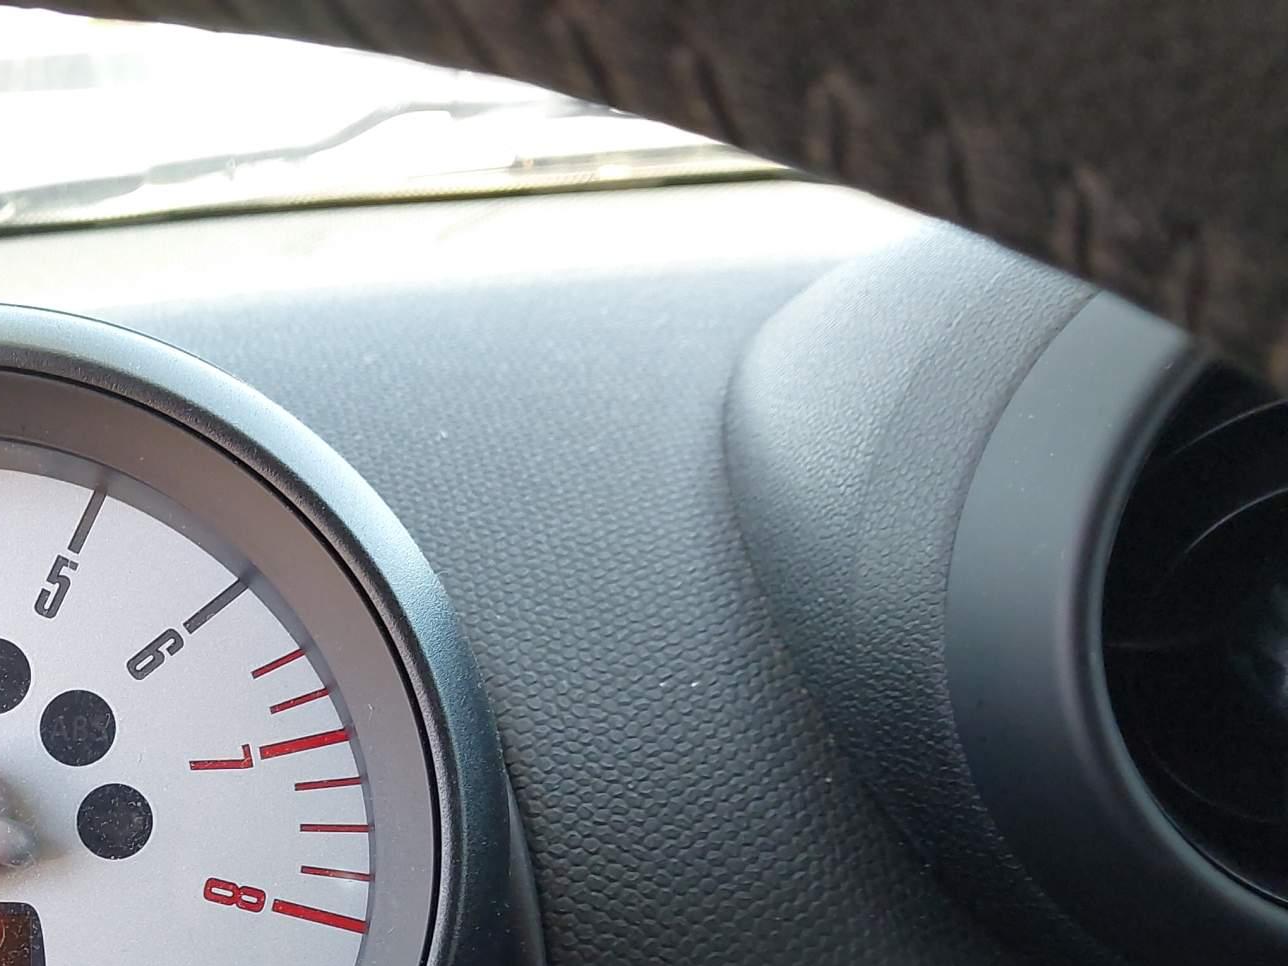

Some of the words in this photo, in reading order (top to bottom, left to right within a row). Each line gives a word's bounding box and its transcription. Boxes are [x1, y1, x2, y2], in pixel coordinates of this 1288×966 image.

[34, 554, 79, 619] 5
[126, 628, 184, 681] 6
[189, 744, 253, 770] 7
[203, 877, 266, 912] 8
